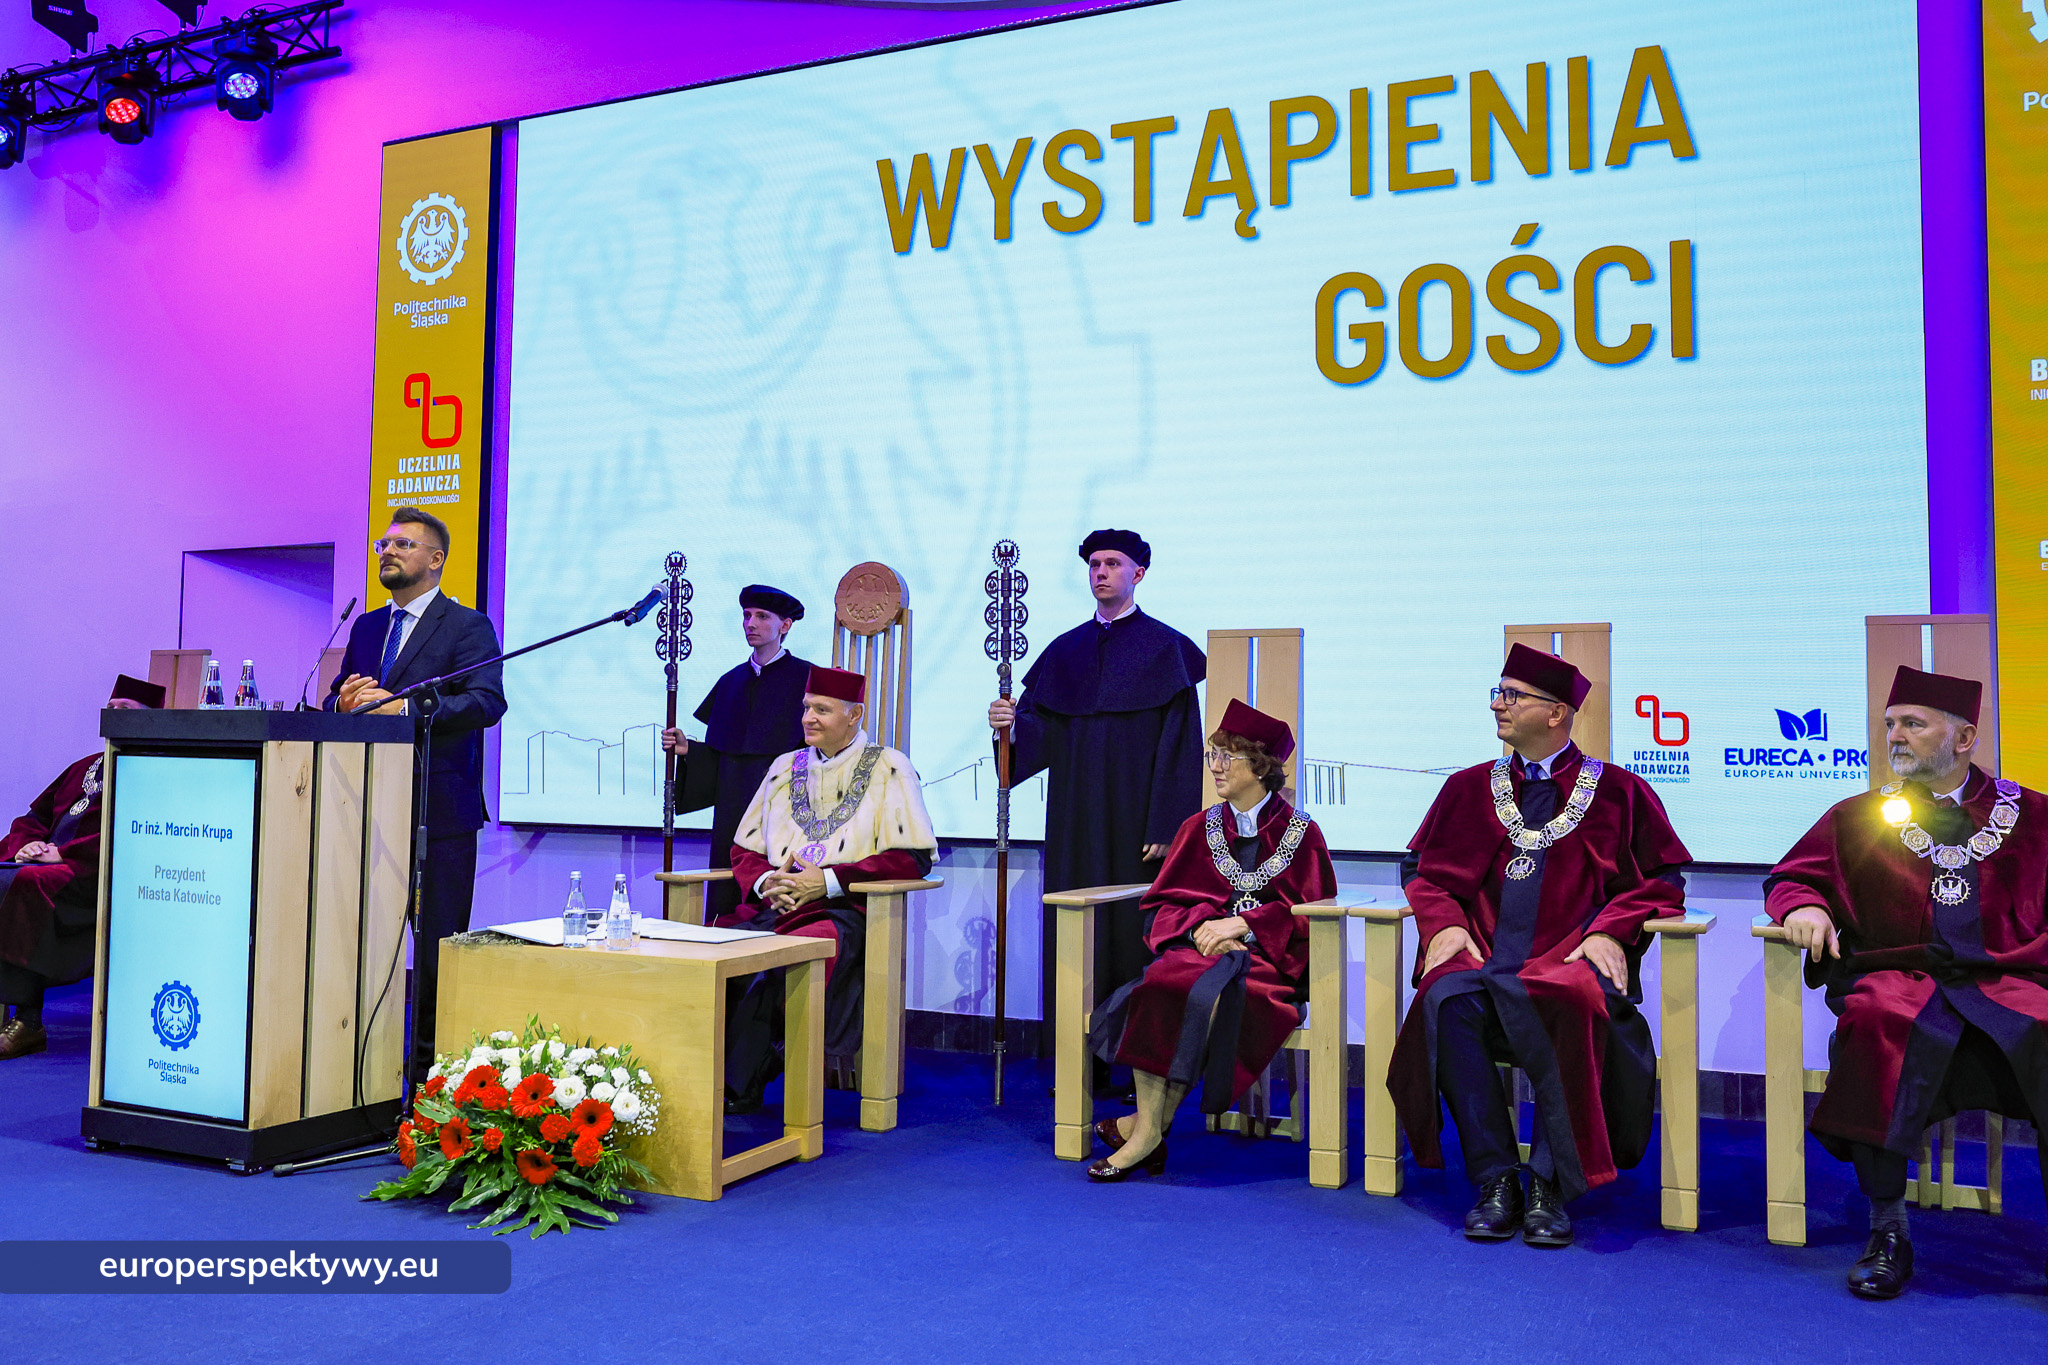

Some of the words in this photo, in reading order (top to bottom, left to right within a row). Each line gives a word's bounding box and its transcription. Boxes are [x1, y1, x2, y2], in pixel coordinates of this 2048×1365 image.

[877, 45, 1697, 254] WYSTĄPIENIA
[394, 295, 467, 316] Politechnika
[1315, 222, 1694, 385] GOŚCI
[410, 312, 449, 328] Śląska
[398, 453, 461, 474] UCZELNIA
[387, 474, 460, 495] BADAWCZA
[1633, 750, 1690, 761] UCZELNIA
[1724, 748, 1814, 767] EURECA
[1625, 763, 1690, 775] BADAWCZA
[1724, 769, 1794, 778] EUROPEAN
[131, 820, 143, 834] Dr
[145, 821, 162, 835] inż.
[165, 822, 199, 837] Marcin
[202, 824, 233, 842] Krupa
[154, 865, 206, 884] Prezydent
[138, 885, 171, 902] Miasta
[173, 888, 221, 906] Katowice
[148, 1058, 200, 1075] Politechnika
[160, 1070, 187, 1085] Śląska
